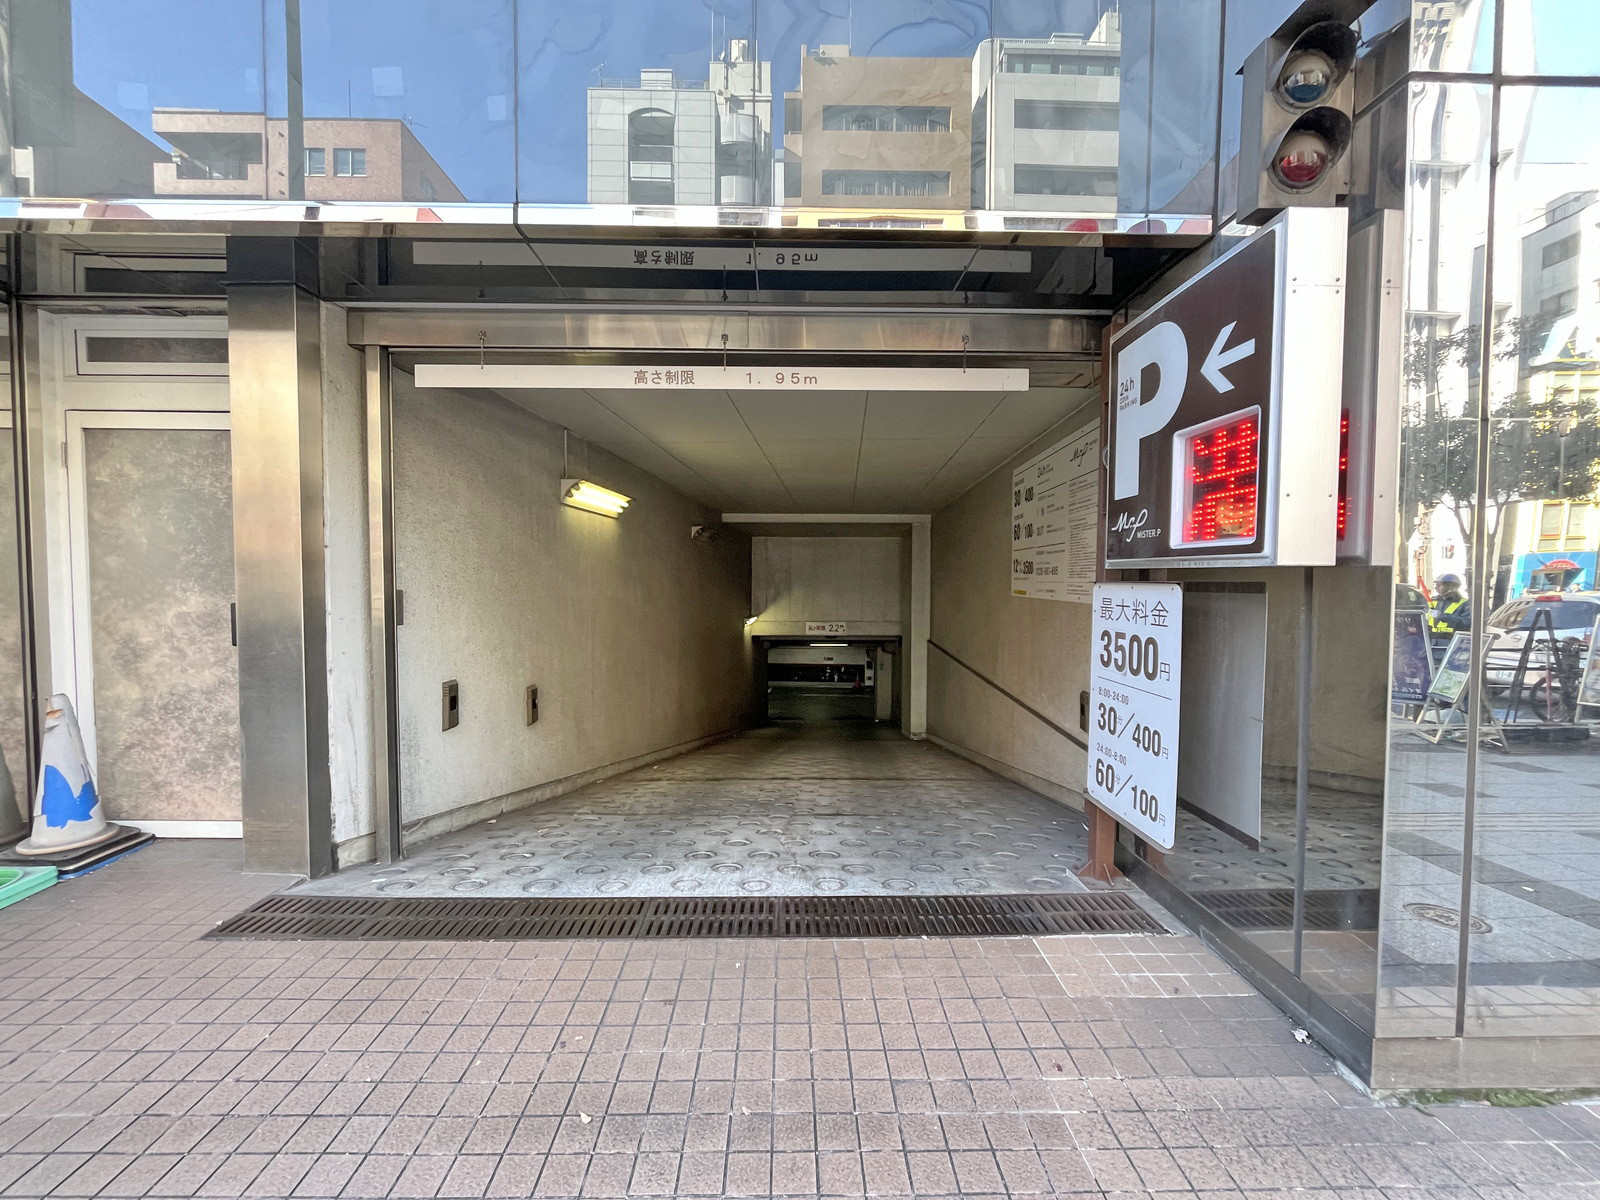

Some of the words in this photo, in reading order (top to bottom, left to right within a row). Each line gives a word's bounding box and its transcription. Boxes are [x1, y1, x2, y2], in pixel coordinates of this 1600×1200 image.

[633, 369, 695, 385] 高さ制限
[1119, 378, 1135, 397] 24h
[1114, 321, 1189, 501] P
[1100, 597, 1169, 628] 最大料金
[1099, 629, 1171, 682] 3500円
[1098, 688, 1130, 706] 8:00-24:00
[1096, 742, 1127, 766] 24:00-8:00
